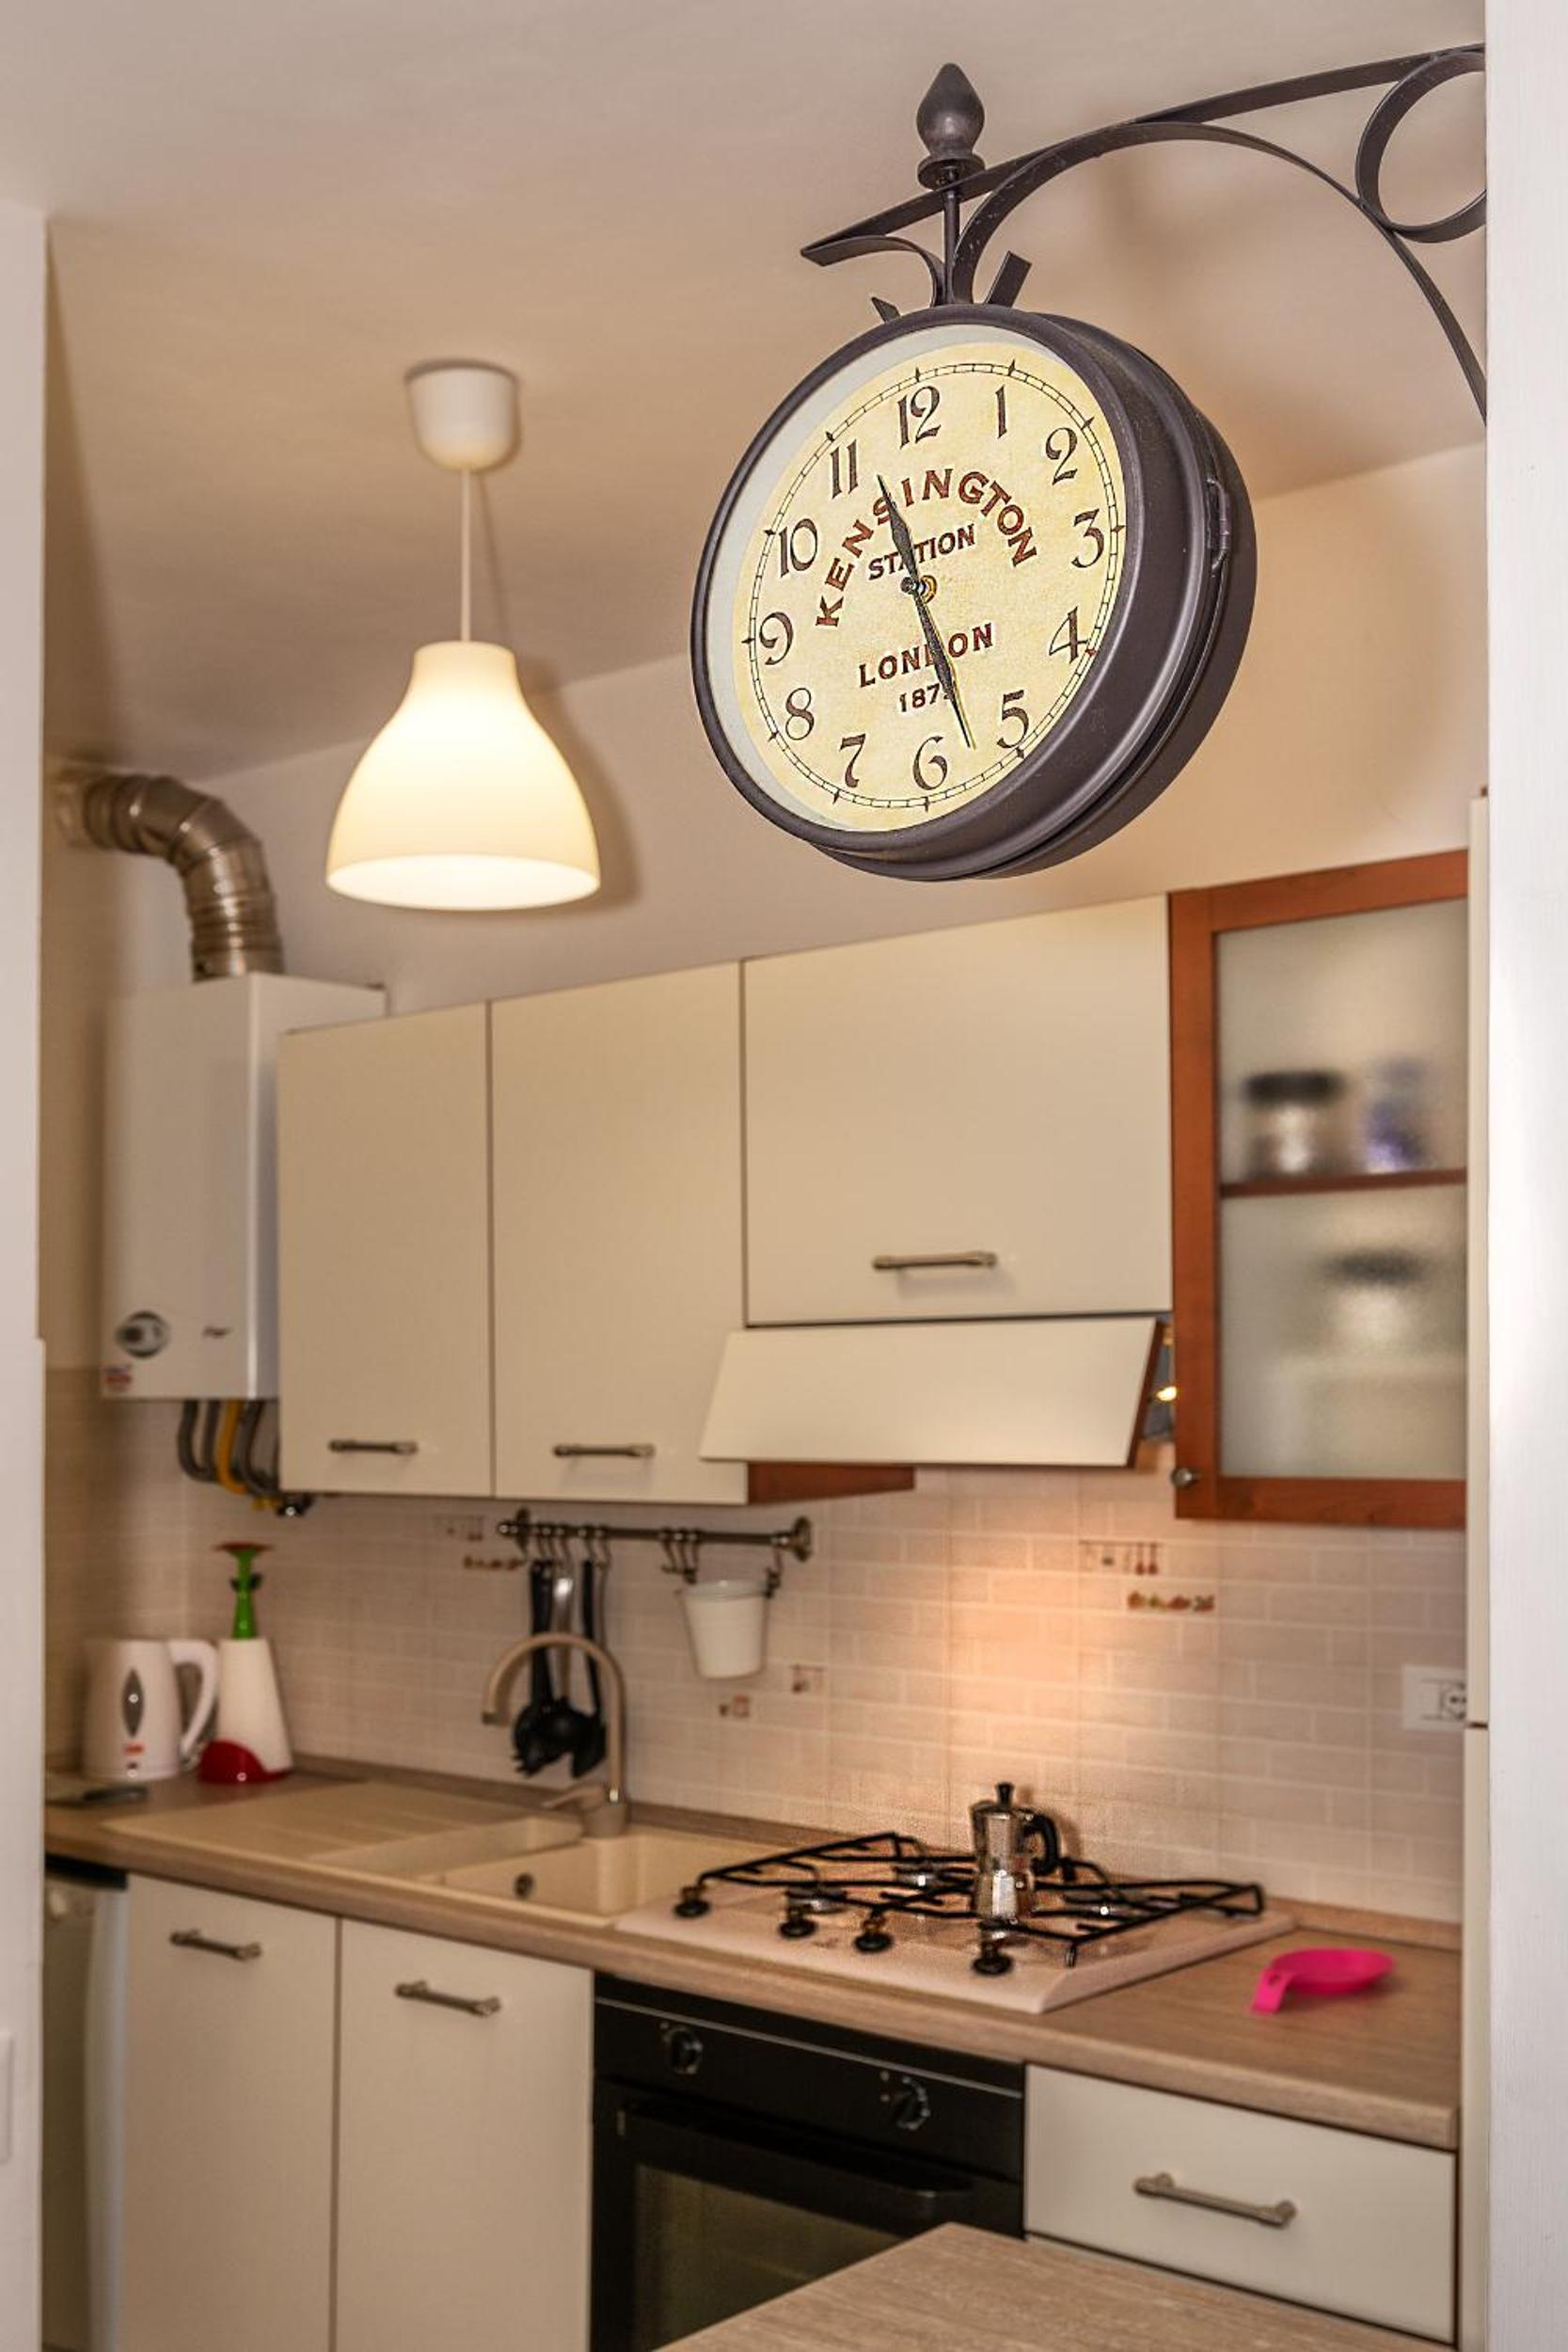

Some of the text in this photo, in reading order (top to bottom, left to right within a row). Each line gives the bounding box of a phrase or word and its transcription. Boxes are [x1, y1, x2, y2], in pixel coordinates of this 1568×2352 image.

[898, 385, 941, 449] 12
[995, 385, 1009, 438] 1
[831, 439, 858, 499] 11
[1045, 427, 1078, 485] 2
[779, 518, 818, 577] 10
[816, 469, 1037, 627] KENSINGTON
[1071, 509, 1104, 568] 3
[758, 612, 794, 665] 9
[1049, 607, 1087, 663] 4
[784, 688, 816, 740] 8
[899, 681, 956, 712] 187
[997, 690, 1029, 749] 5
[839, 734, 866, 788] 7
[911, 737, 948, 790] 6
